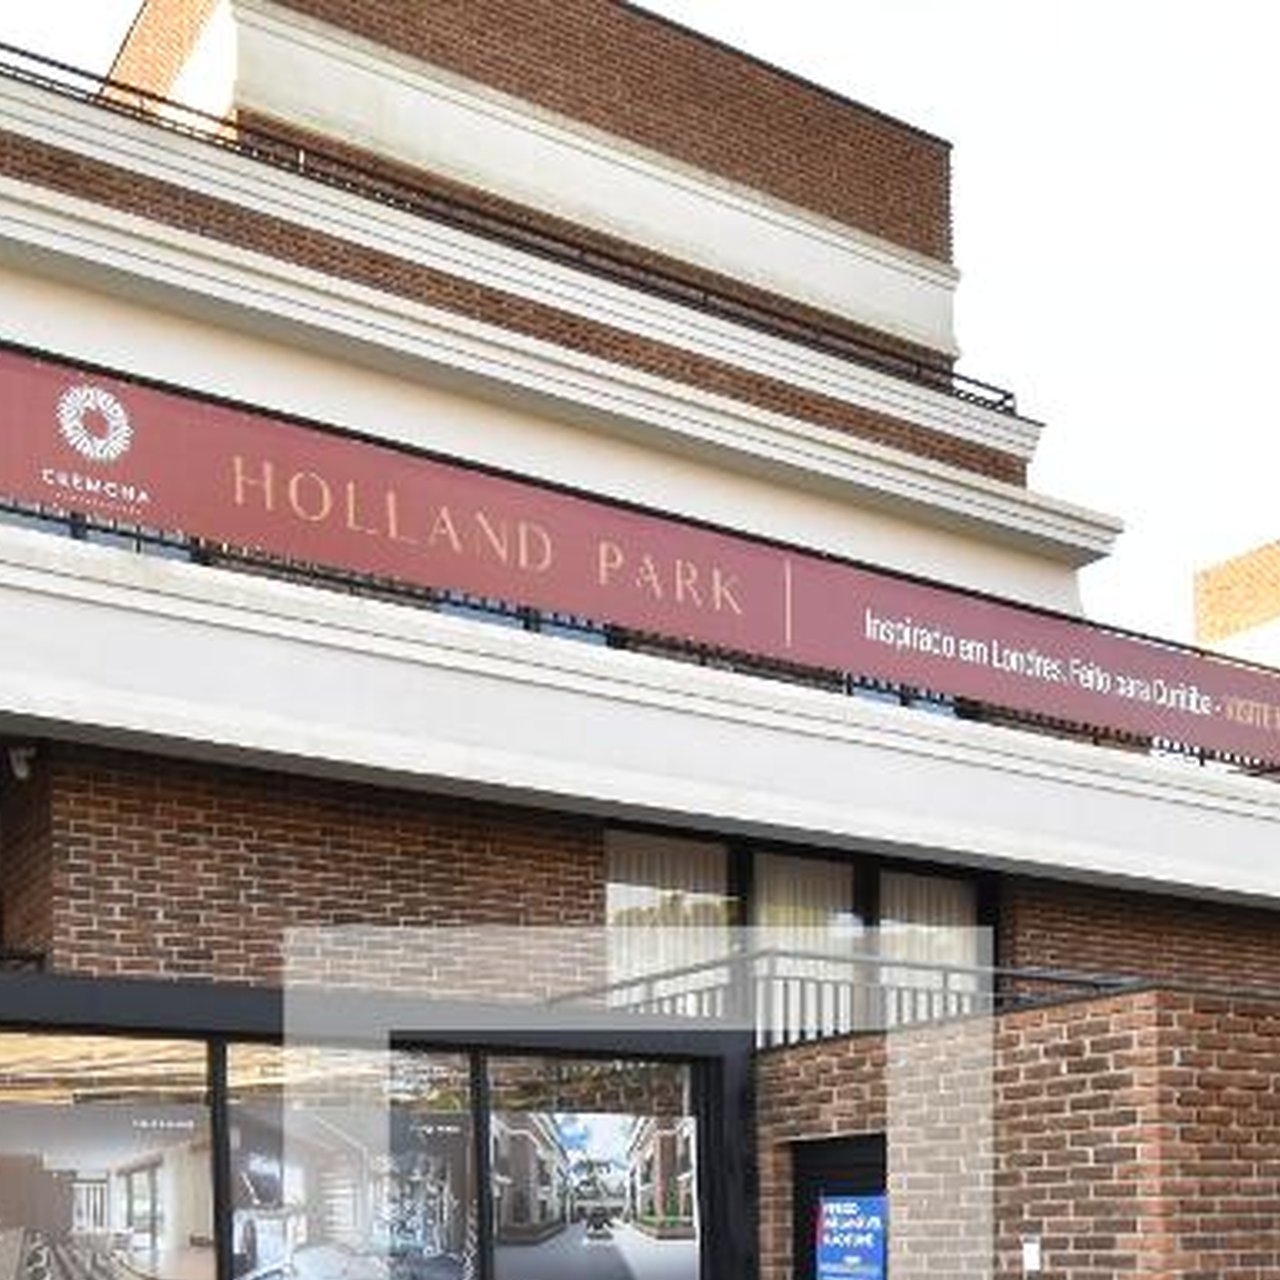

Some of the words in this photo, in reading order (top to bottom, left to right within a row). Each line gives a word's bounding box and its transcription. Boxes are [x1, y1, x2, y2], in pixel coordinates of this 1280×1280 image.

[233, 455, 553, 571] HOLLAND
[597, 540, 742, 615] PARK
[958, 636, 989, 666] em
